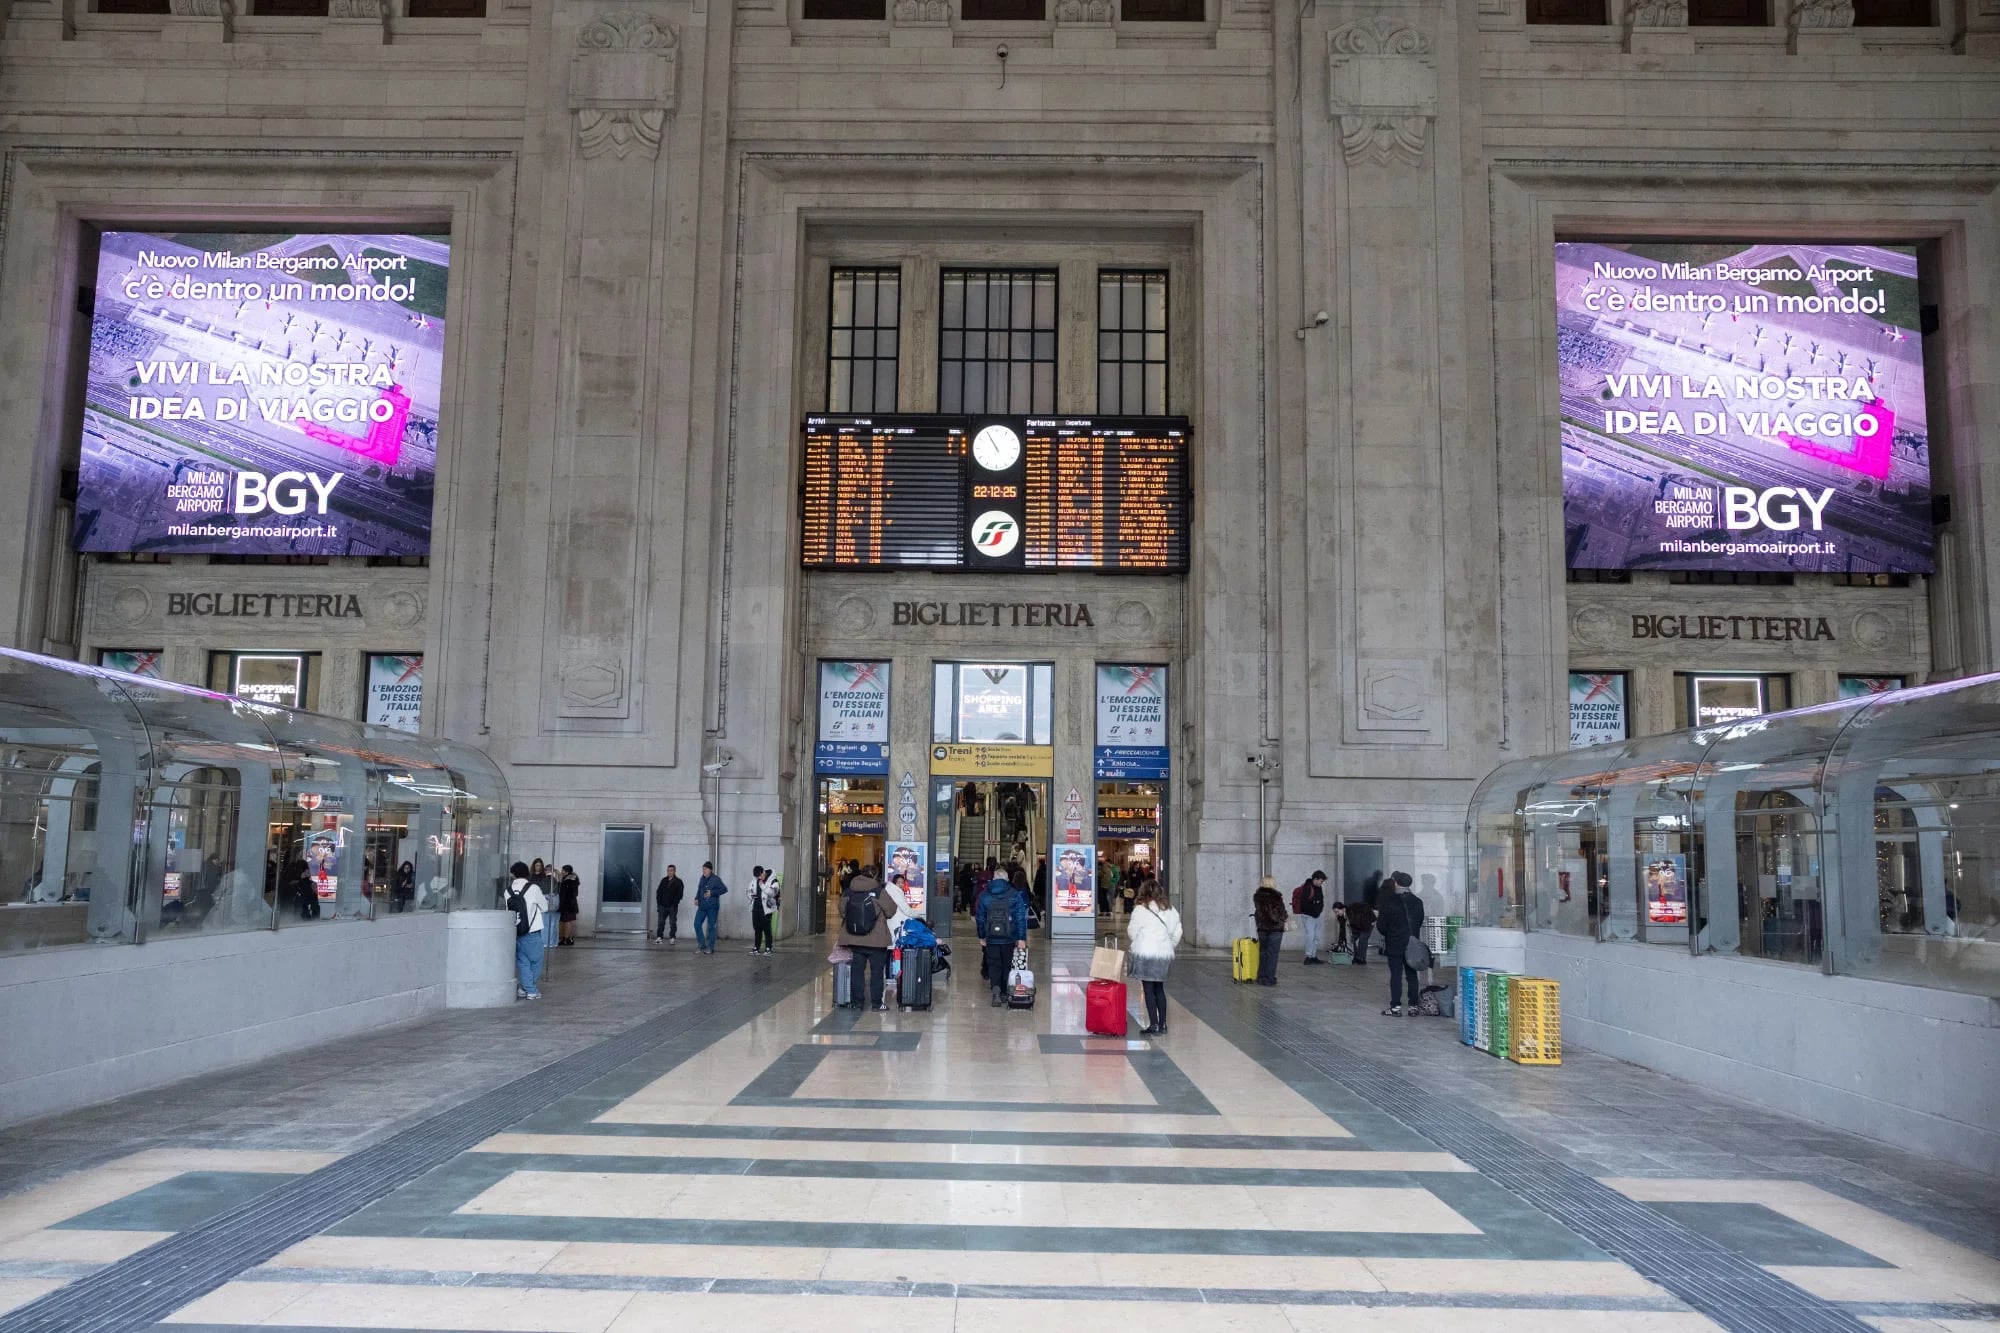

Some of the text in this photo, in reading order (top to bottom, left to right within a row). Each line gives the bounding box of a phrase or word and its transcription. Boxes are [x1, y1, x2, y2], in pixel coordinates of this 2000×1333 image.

[137, 250, 407, 274] Nuovo Milan Bergamo Airport
[1594, 262, 1873, 286] Nuovo Milan Bergamo Airport
[168, 275, 261, 300] dentro
[271, 282, 302, 301] un
[311, 277, 416, 302] mondo!
[1632, 286, 1726, 312] dentro
[1735, 294, 1769, 313] un
[1777, 289, 1885, 314] mondo!
[135, 361, 393, 386] VIVI LA NOSTRA
[1605, 374, 1875, 400] VIVI LA NOSTRA
[129, 398, 394, 422] IDEA DI VIAGGIO
[1605, 411, 1878, 437] IDEA DI VIAGGIO
[187, 472, 224, 485] MILAN
[168, 485, 223, 499] BERGAMO
[235, 472, 344, 515] BGY
[974, 486, 1016, 497] 22-12-25
[1674, 487, 1712, 500] MILAN
[176, 499, 223, 512] AIRPORT
[1655, 501, 1712, 514] BERGAMO
[1725, 487, 1835, 531] BGY
[1666, 515, 1714, 529] AIRPORT
[168, 524, 337, 539] milanbergamoairport.it
[1660, 540, 1835, 555] milanbergamoairport.it
[167, 592, 363, 618] BIGLIETTERIA
[892, 601, 1095, 627] BIGLIETTERIA
[1631, 615, 1836, 641] BIGLIETTERIA
[239, 684, 295, 694] SHOPPING
[824, 691, 885, 700] L'EMOZIONE
[252, 694, 280, 702] AREA
[964, 695, 1022, 704] SHOPPING
[1101, 696, 1162, 704] L'EMOZIONE
[840, 710, 884, 718] ITALIANI
[978, 705, 1008, 713] AREA
[1700, 707, 1759, 716] SHOPPING
[1117, 714, 1161, 722] ITALIANI
[948, 747, 972, 755] Treni
